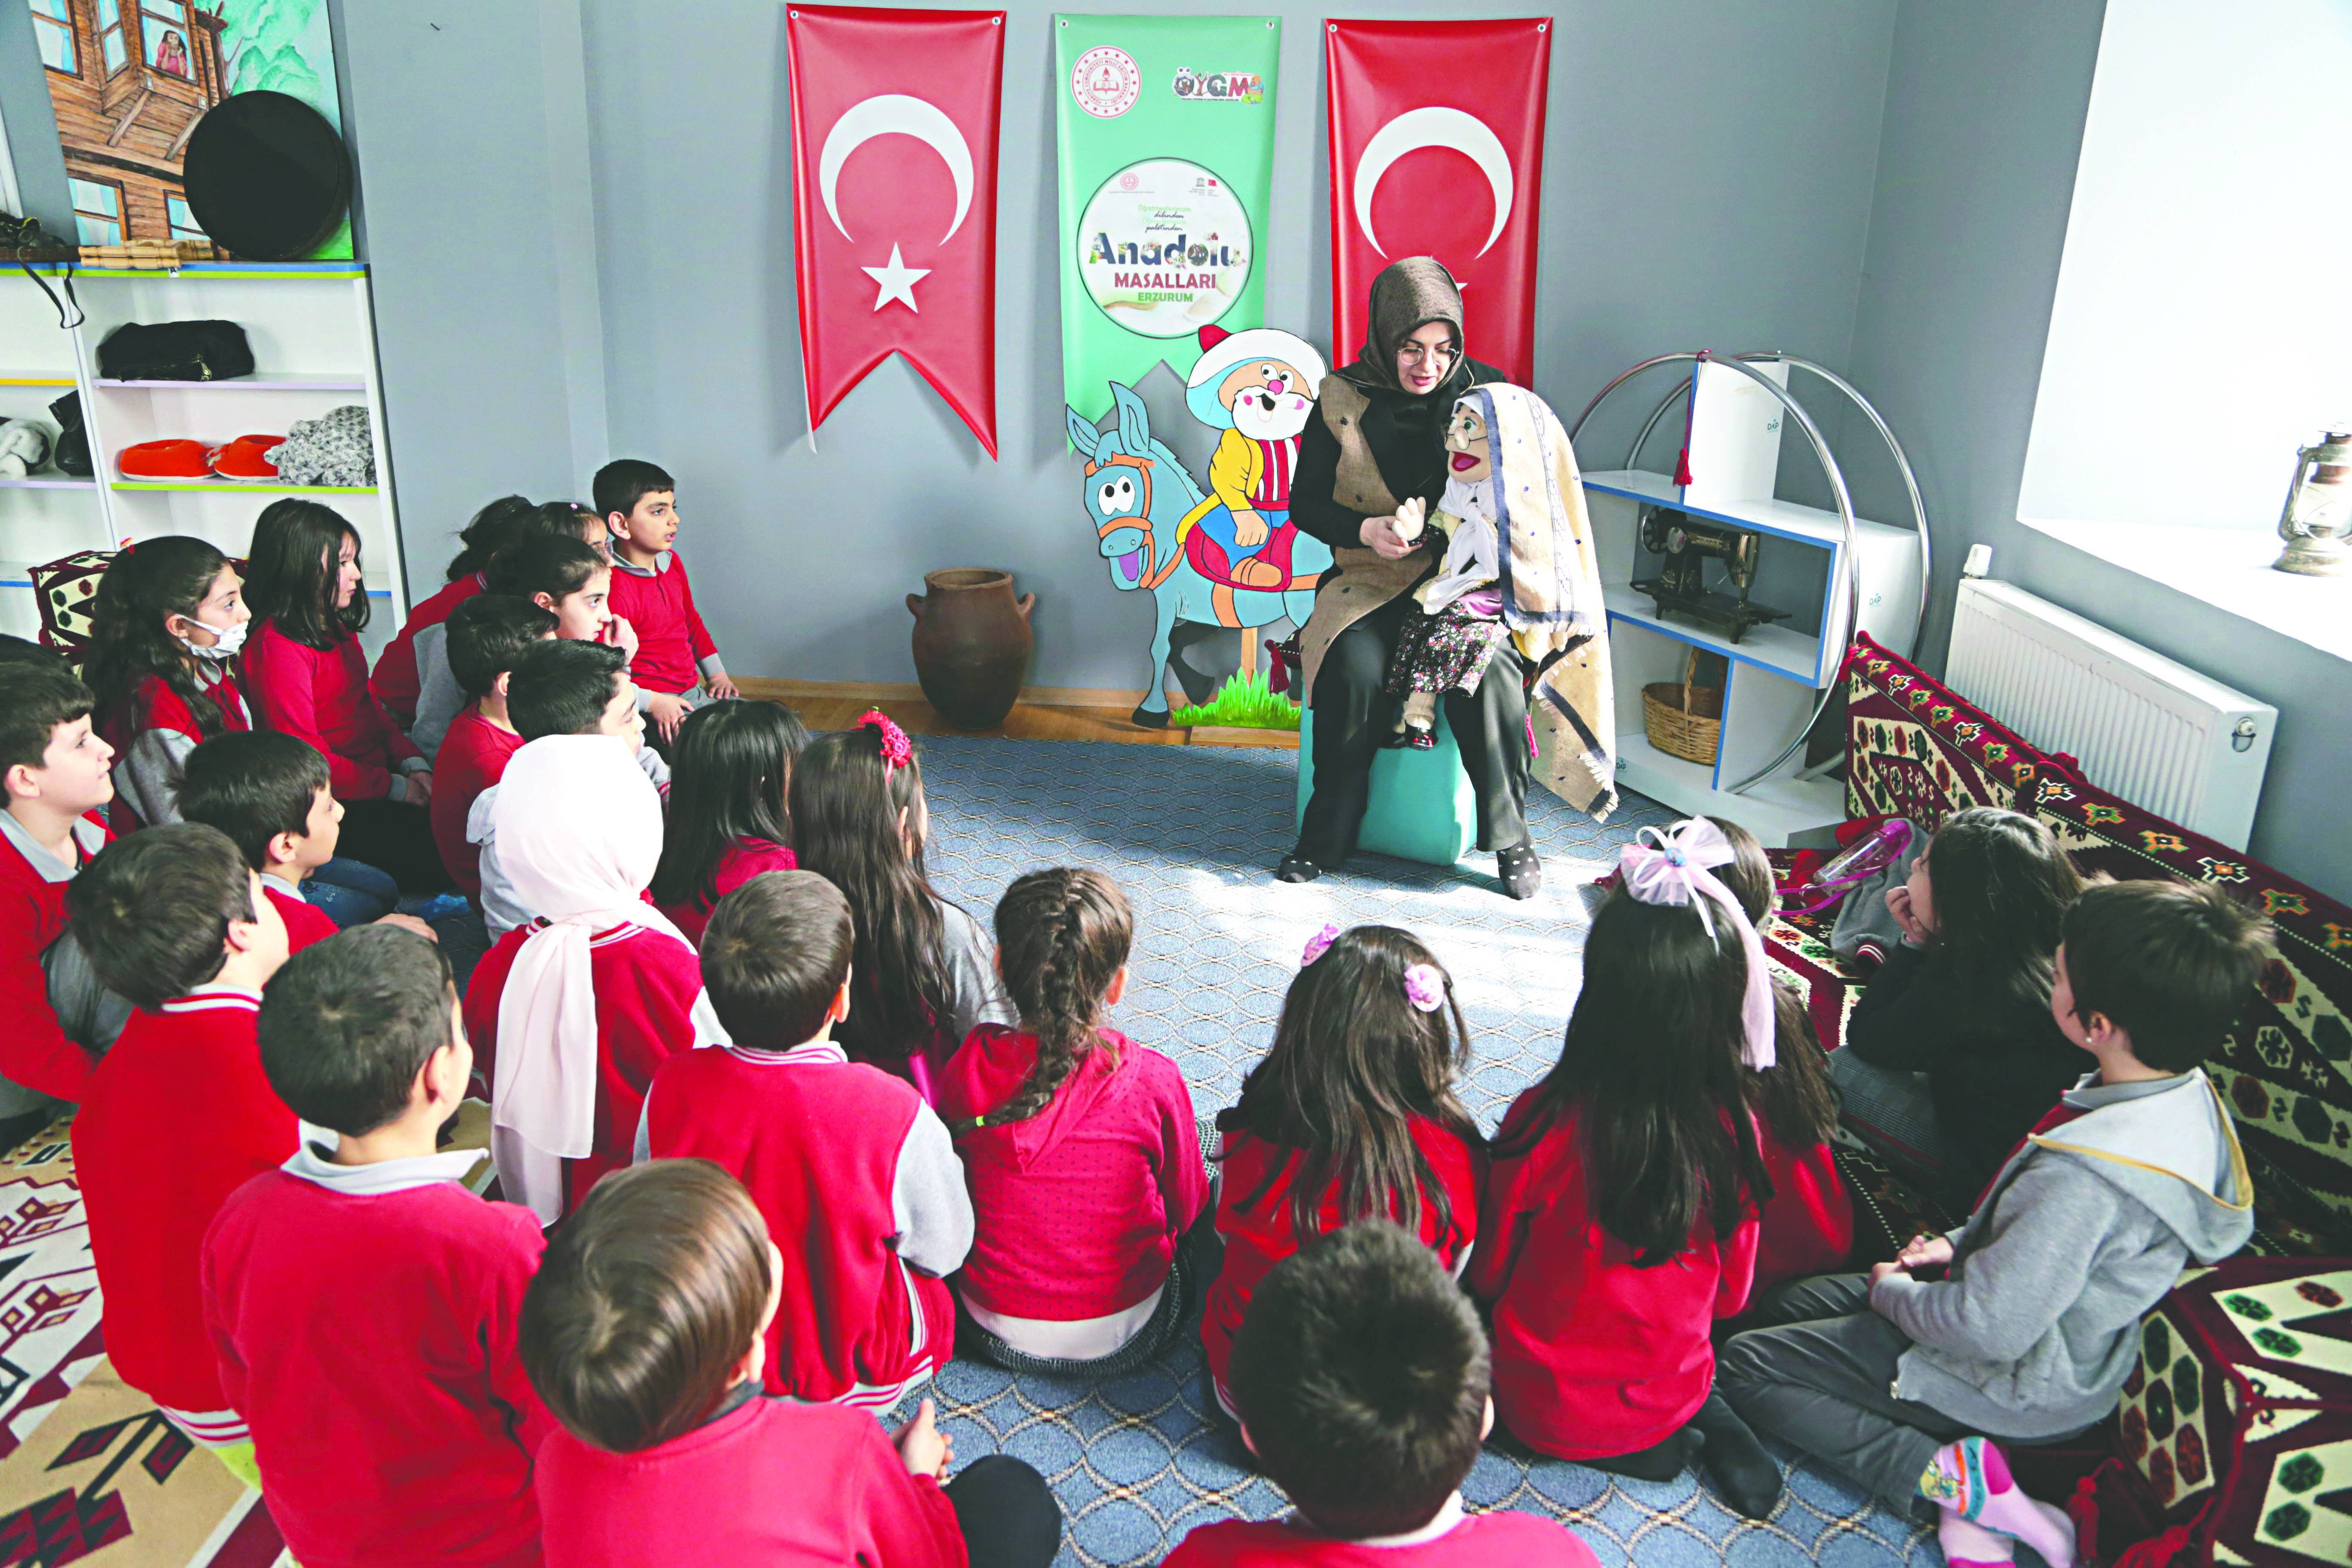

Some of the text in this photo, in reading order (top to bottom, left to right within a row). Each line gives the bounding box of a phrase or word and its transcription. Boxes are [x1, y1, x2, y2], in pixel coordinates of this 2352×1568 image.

[1138, 204, 1191, 212] Öğretmenlerimizin
[1089, 232, 1246, 269] Anadolu
[1115, 273, 1217, 288] MASALLARI
[1138, 292, 1193, 302] ERZURUM
[1869, 596, 1881, 605] DAP
